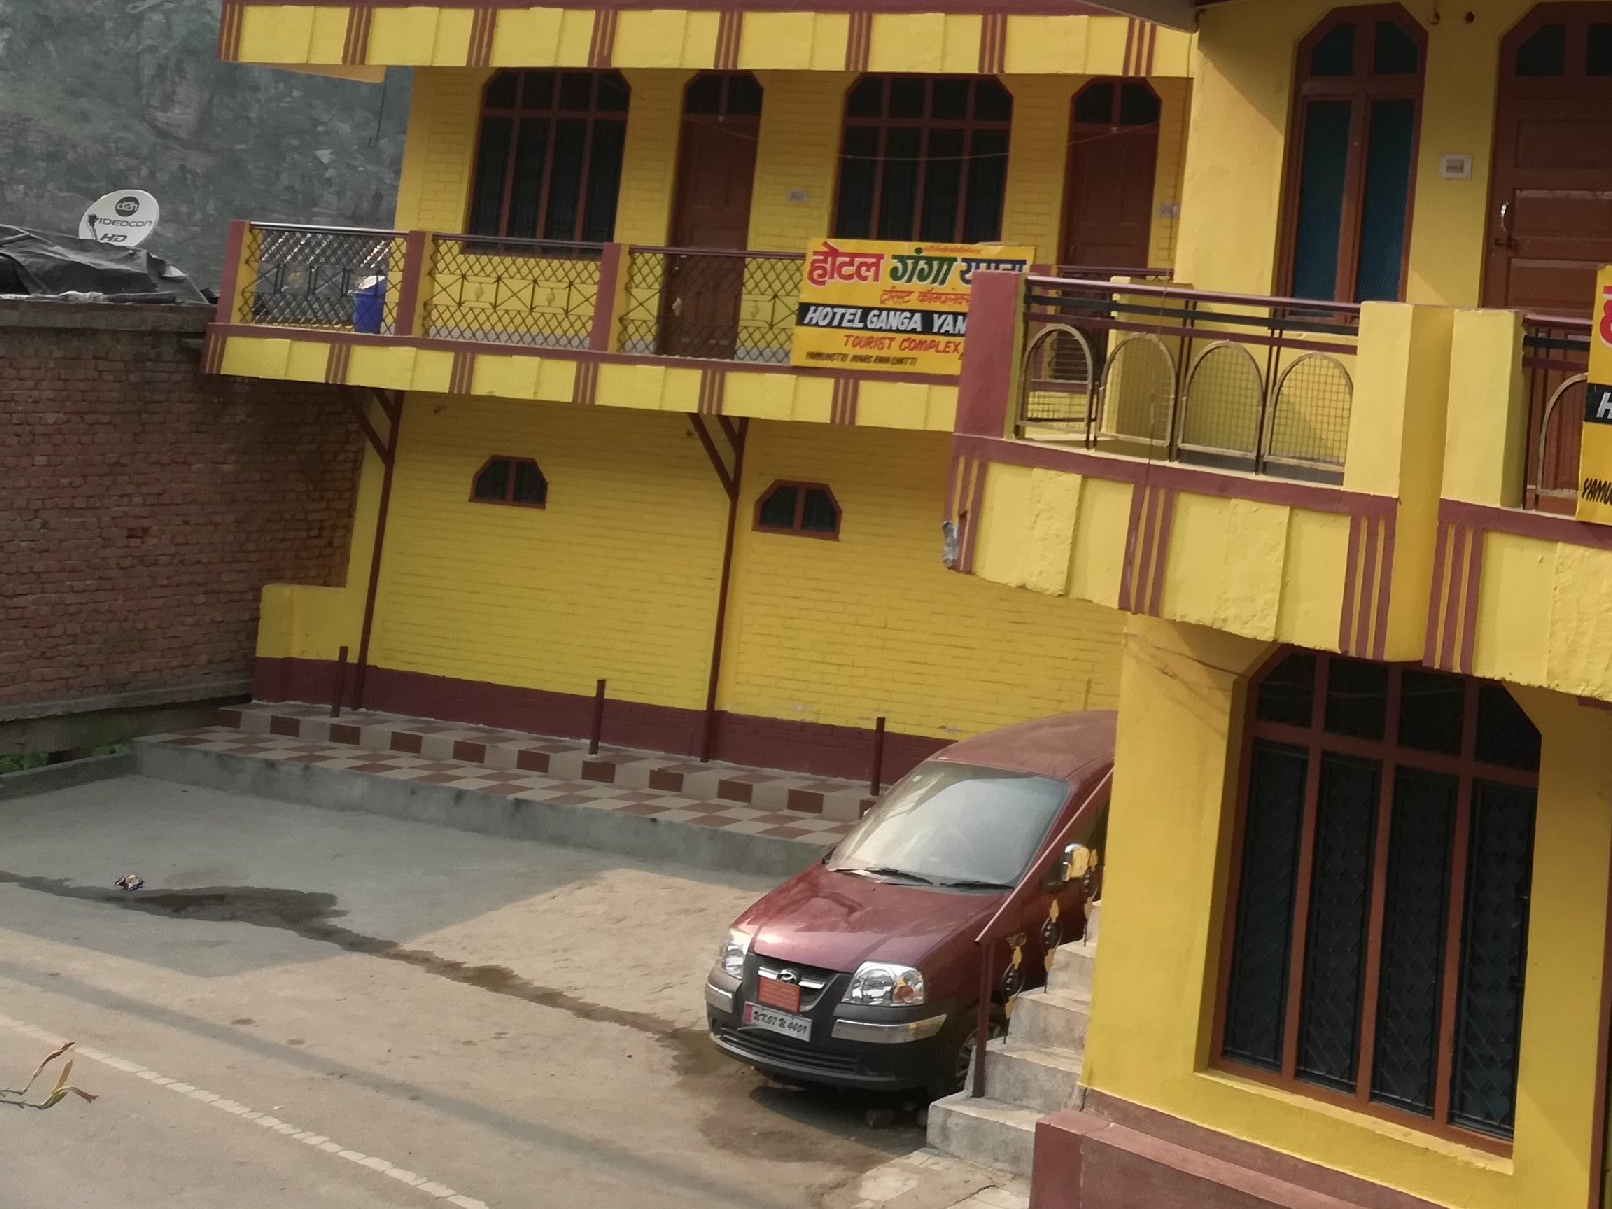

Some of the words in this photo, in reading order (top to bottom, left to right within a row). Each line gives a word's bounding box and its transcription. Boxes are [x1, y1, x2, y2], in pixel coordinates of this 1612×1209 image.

[806, 240, 885, 287] होटल
[889, 246, 958, 287] गंगा
[803, 306, 865, 328] HOTEL
[867, 309, 922, 332] GANGA
[931, 313, 968, 335] YAM
[843, 334, 896, 351] TOURIST
[898, 337, 962, 355] COMPLEX
